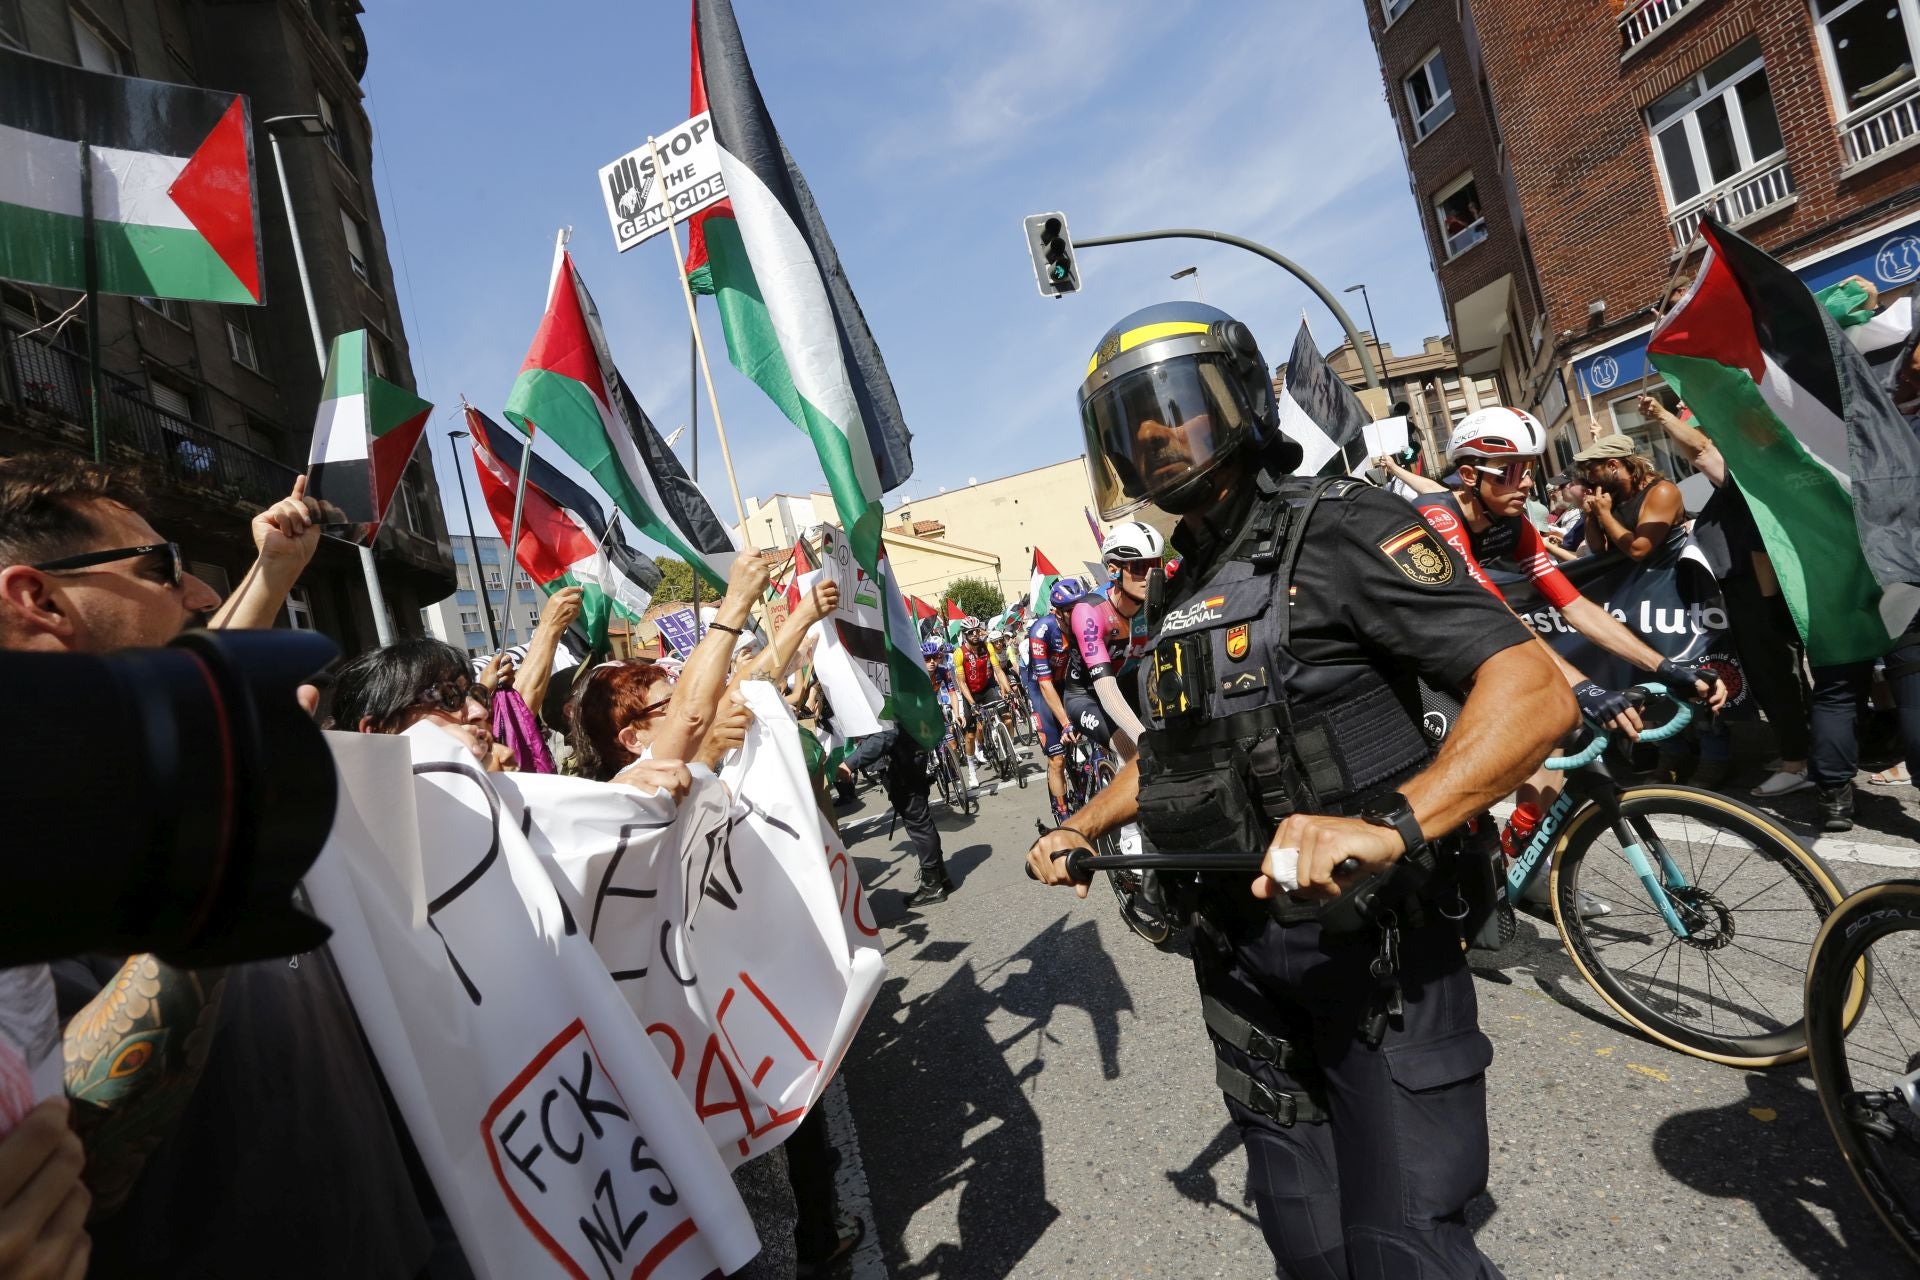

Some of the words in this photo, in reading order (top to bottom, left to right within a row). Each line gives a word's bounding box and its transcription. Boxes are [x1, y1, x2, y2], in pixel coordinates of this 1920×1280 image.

[640, 118, 710, 175] STOP
[663, 163, 696, 190] THE
[620, 174, 725, 239] GENOCIDE
[1402, 563, 1437, 583] POLICIA
[1437, 546, 1451, 581] NACIONAL
[1160, 609, 1222, 635] NACIONAL
[1640, 600, 1728, 635] luto
[1698, 652, 1729, 663] Comité
[1080, 711, 1099, 731] lotto
[1423, 718, 1442, 736] B&B
[1507, 790, 1574, 889] Bianchi
[1846, 909, 1903, 938] BORA
[498, 1051, 630, 1194] FCK
[578, 1136, 679, 1280] NZS
